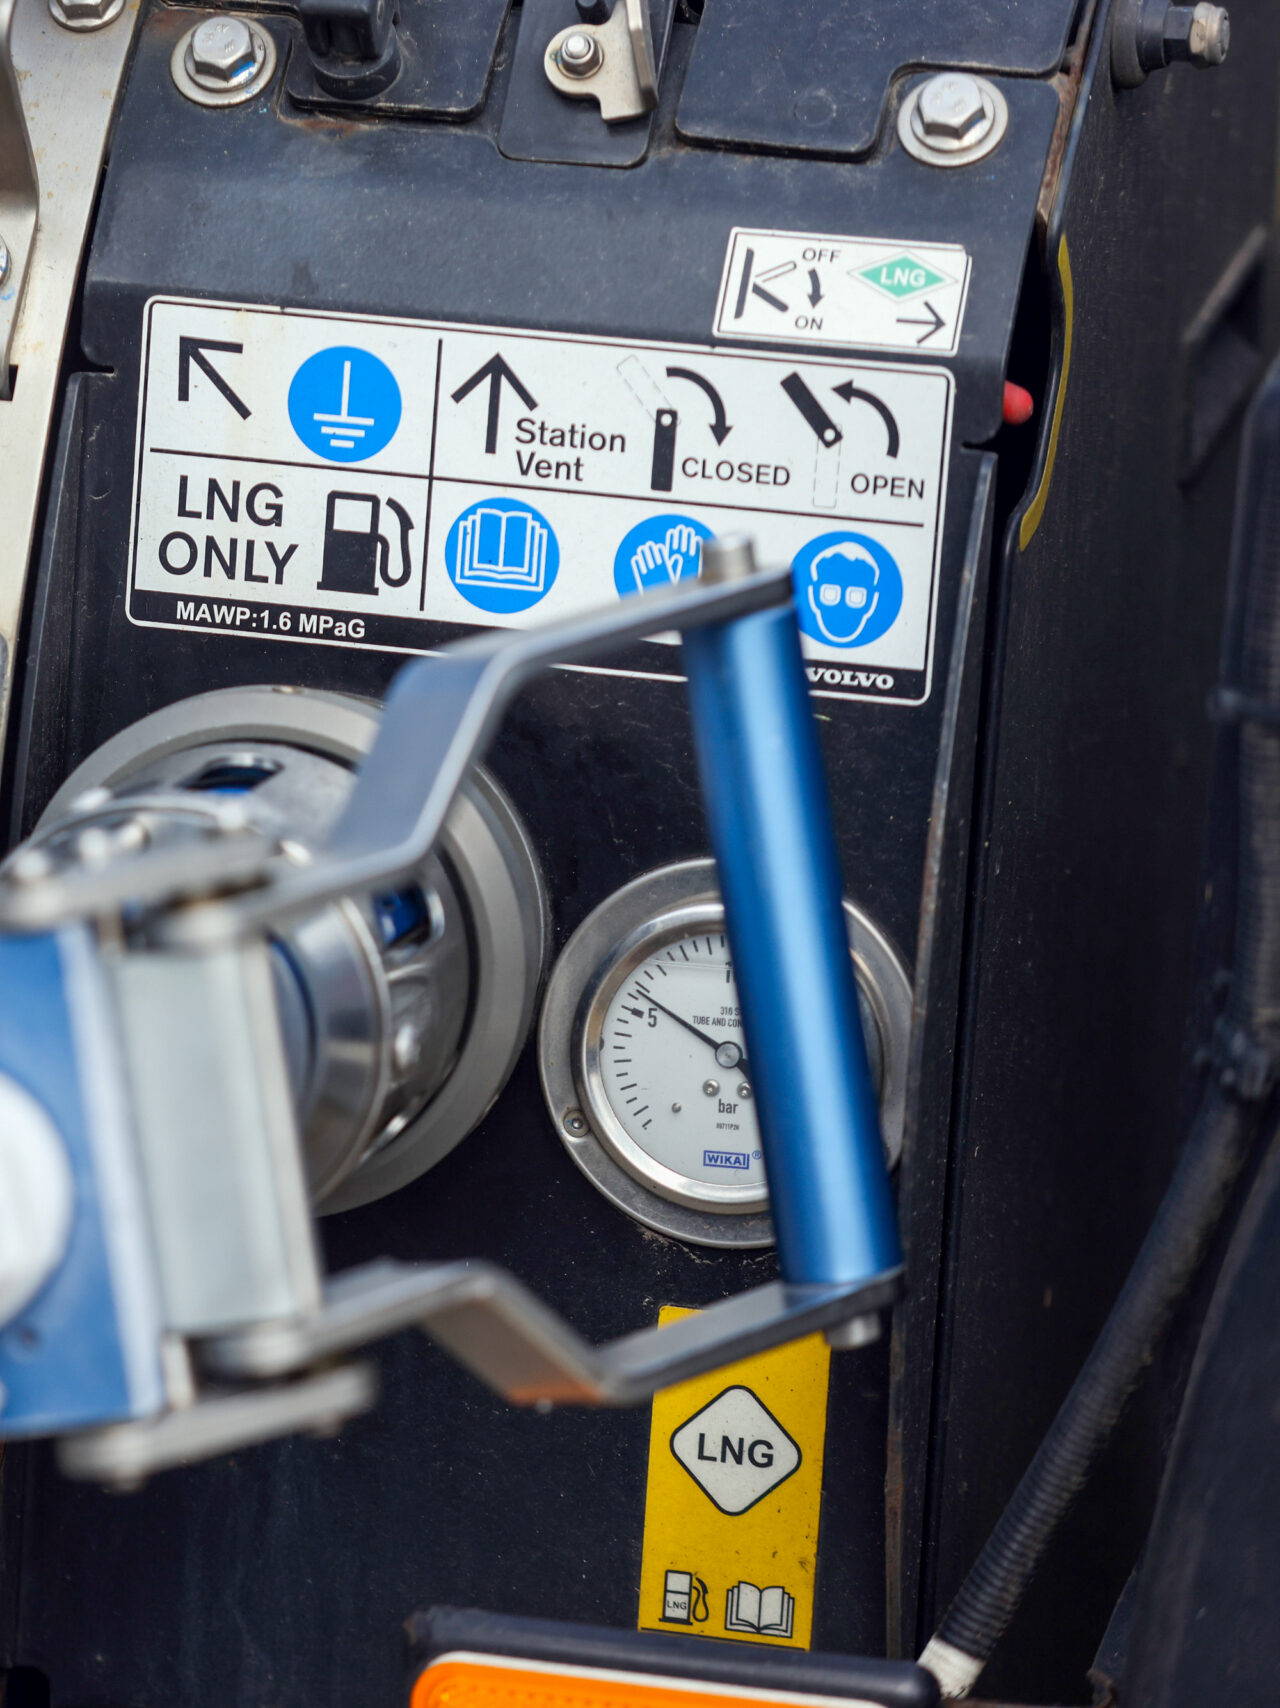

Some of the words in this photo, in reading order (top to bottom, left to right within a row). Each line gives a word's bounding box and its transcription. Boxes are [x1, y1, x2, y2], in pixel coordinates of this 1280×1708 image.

[801, 247, 842, 264] OFF
[879, 266, 927, 288] LNG
[794, 315, 824, 331] ON
[514, 417, 627, 453] Station
[516, 450, 585, 482] Vent
[681, 457, 791, 487] CLOSED
[850, 473, 926, 500] OPEN
[177, 474, 284, 527] LNG
[158, 531, 299, 585] ONLY
[176, 600, 292, 631] MAWP:1.6
[298, 613, 366, 639] MPaG
[804, 666, 894, 690] VOLVO
[647, 1008, 658, 1029] 5
[693, 1015, 710, 1026] TUBE
[711, 1017, 727, 1027] AND
[718, 1098, 739, 1114] bar
[696, 1432, 775, 1469] LNG
[666, 1599, 688, 1611] LNG
